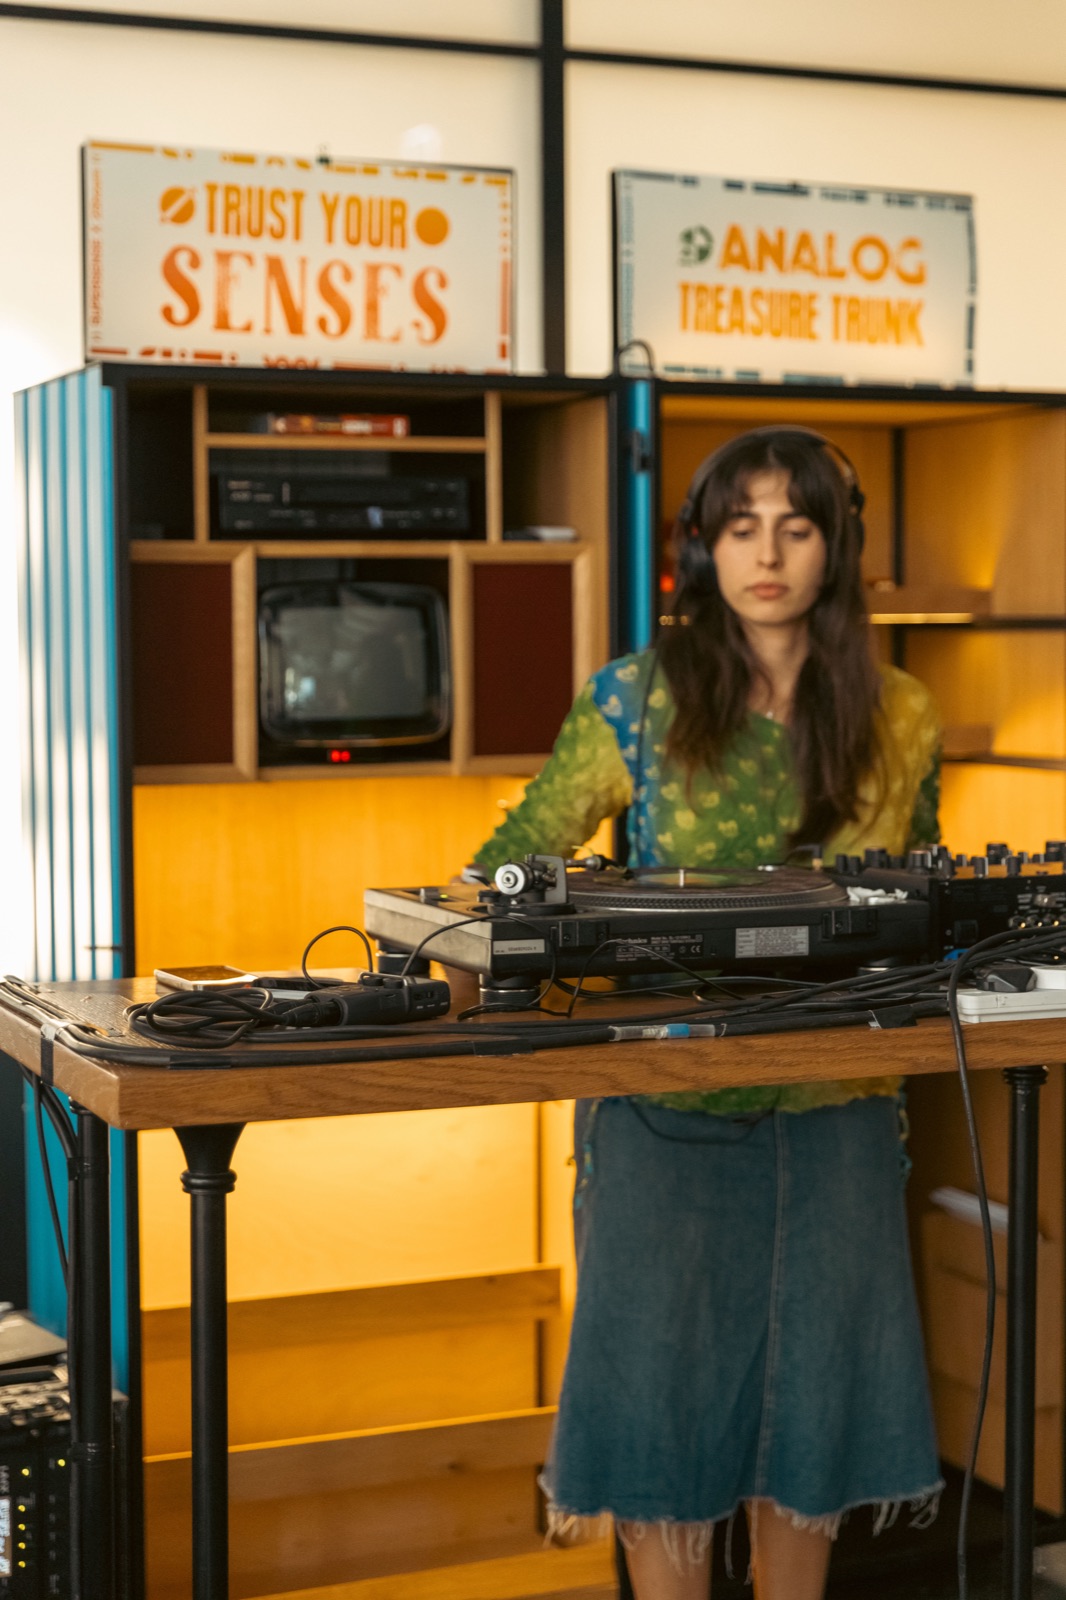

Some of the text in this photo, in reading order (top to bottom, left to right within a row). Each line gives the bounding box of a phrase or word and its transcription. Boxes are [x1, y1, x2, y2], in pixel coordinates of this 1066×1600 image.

[206, 182, 409, 249] TRUST YOUR
[719, 223, 927, 286] ANALOG
[160, 244, 450, 345] SENSES
[679, 281, 819, 341] TREASURE
[831, 293, 925, 346] TRUNK
